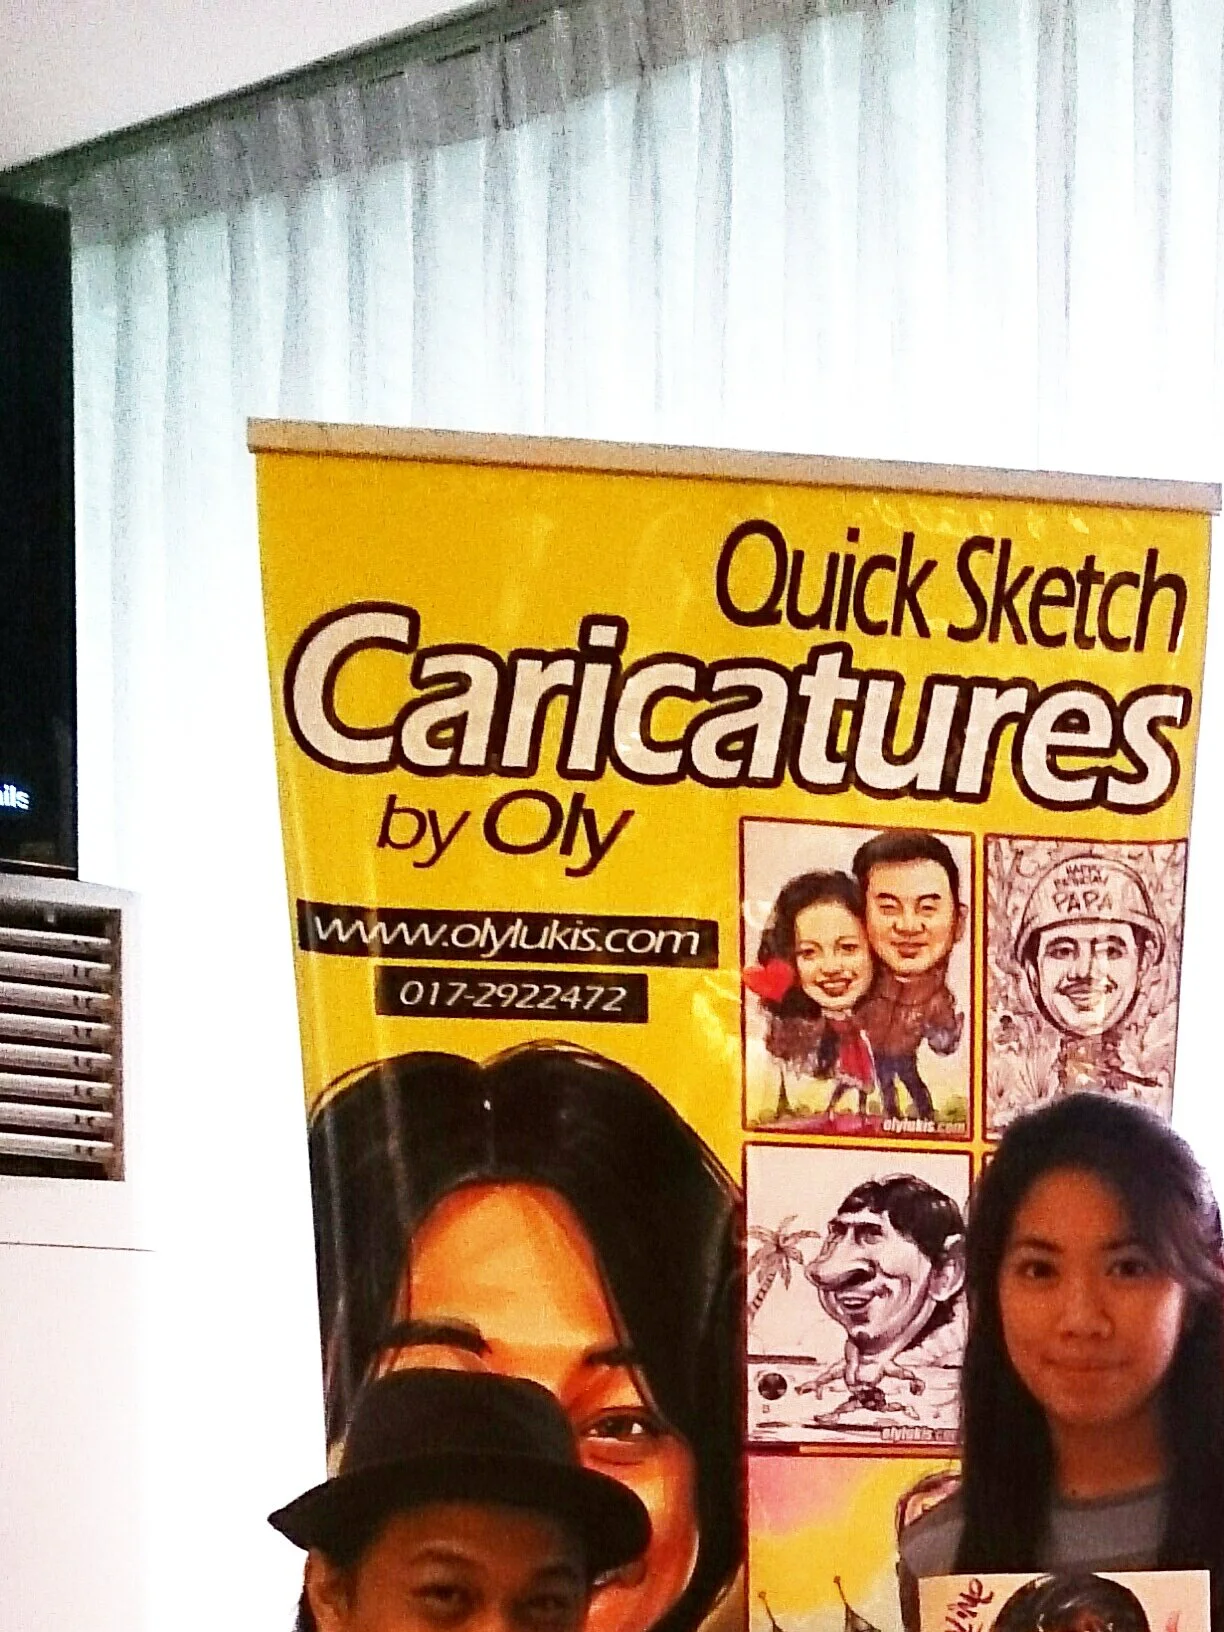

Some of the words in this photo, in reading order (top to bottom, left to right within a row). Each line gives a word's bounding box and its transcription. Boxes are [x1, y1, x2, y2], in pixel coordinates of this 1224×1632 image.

[715, 518, 938, 639] Quick
[946, 534, 1189, 654] Sketch
[284, 600, 1194, 812] Caricatures
[376, 793, 472, 869] by
[482, 788, 636, 878] Oly
[1051, 890, 1113, 913] PAPA
[313, 916, 701, 959] www.olylukis.com
[399, 980, 628, 1012] 017-2922472
